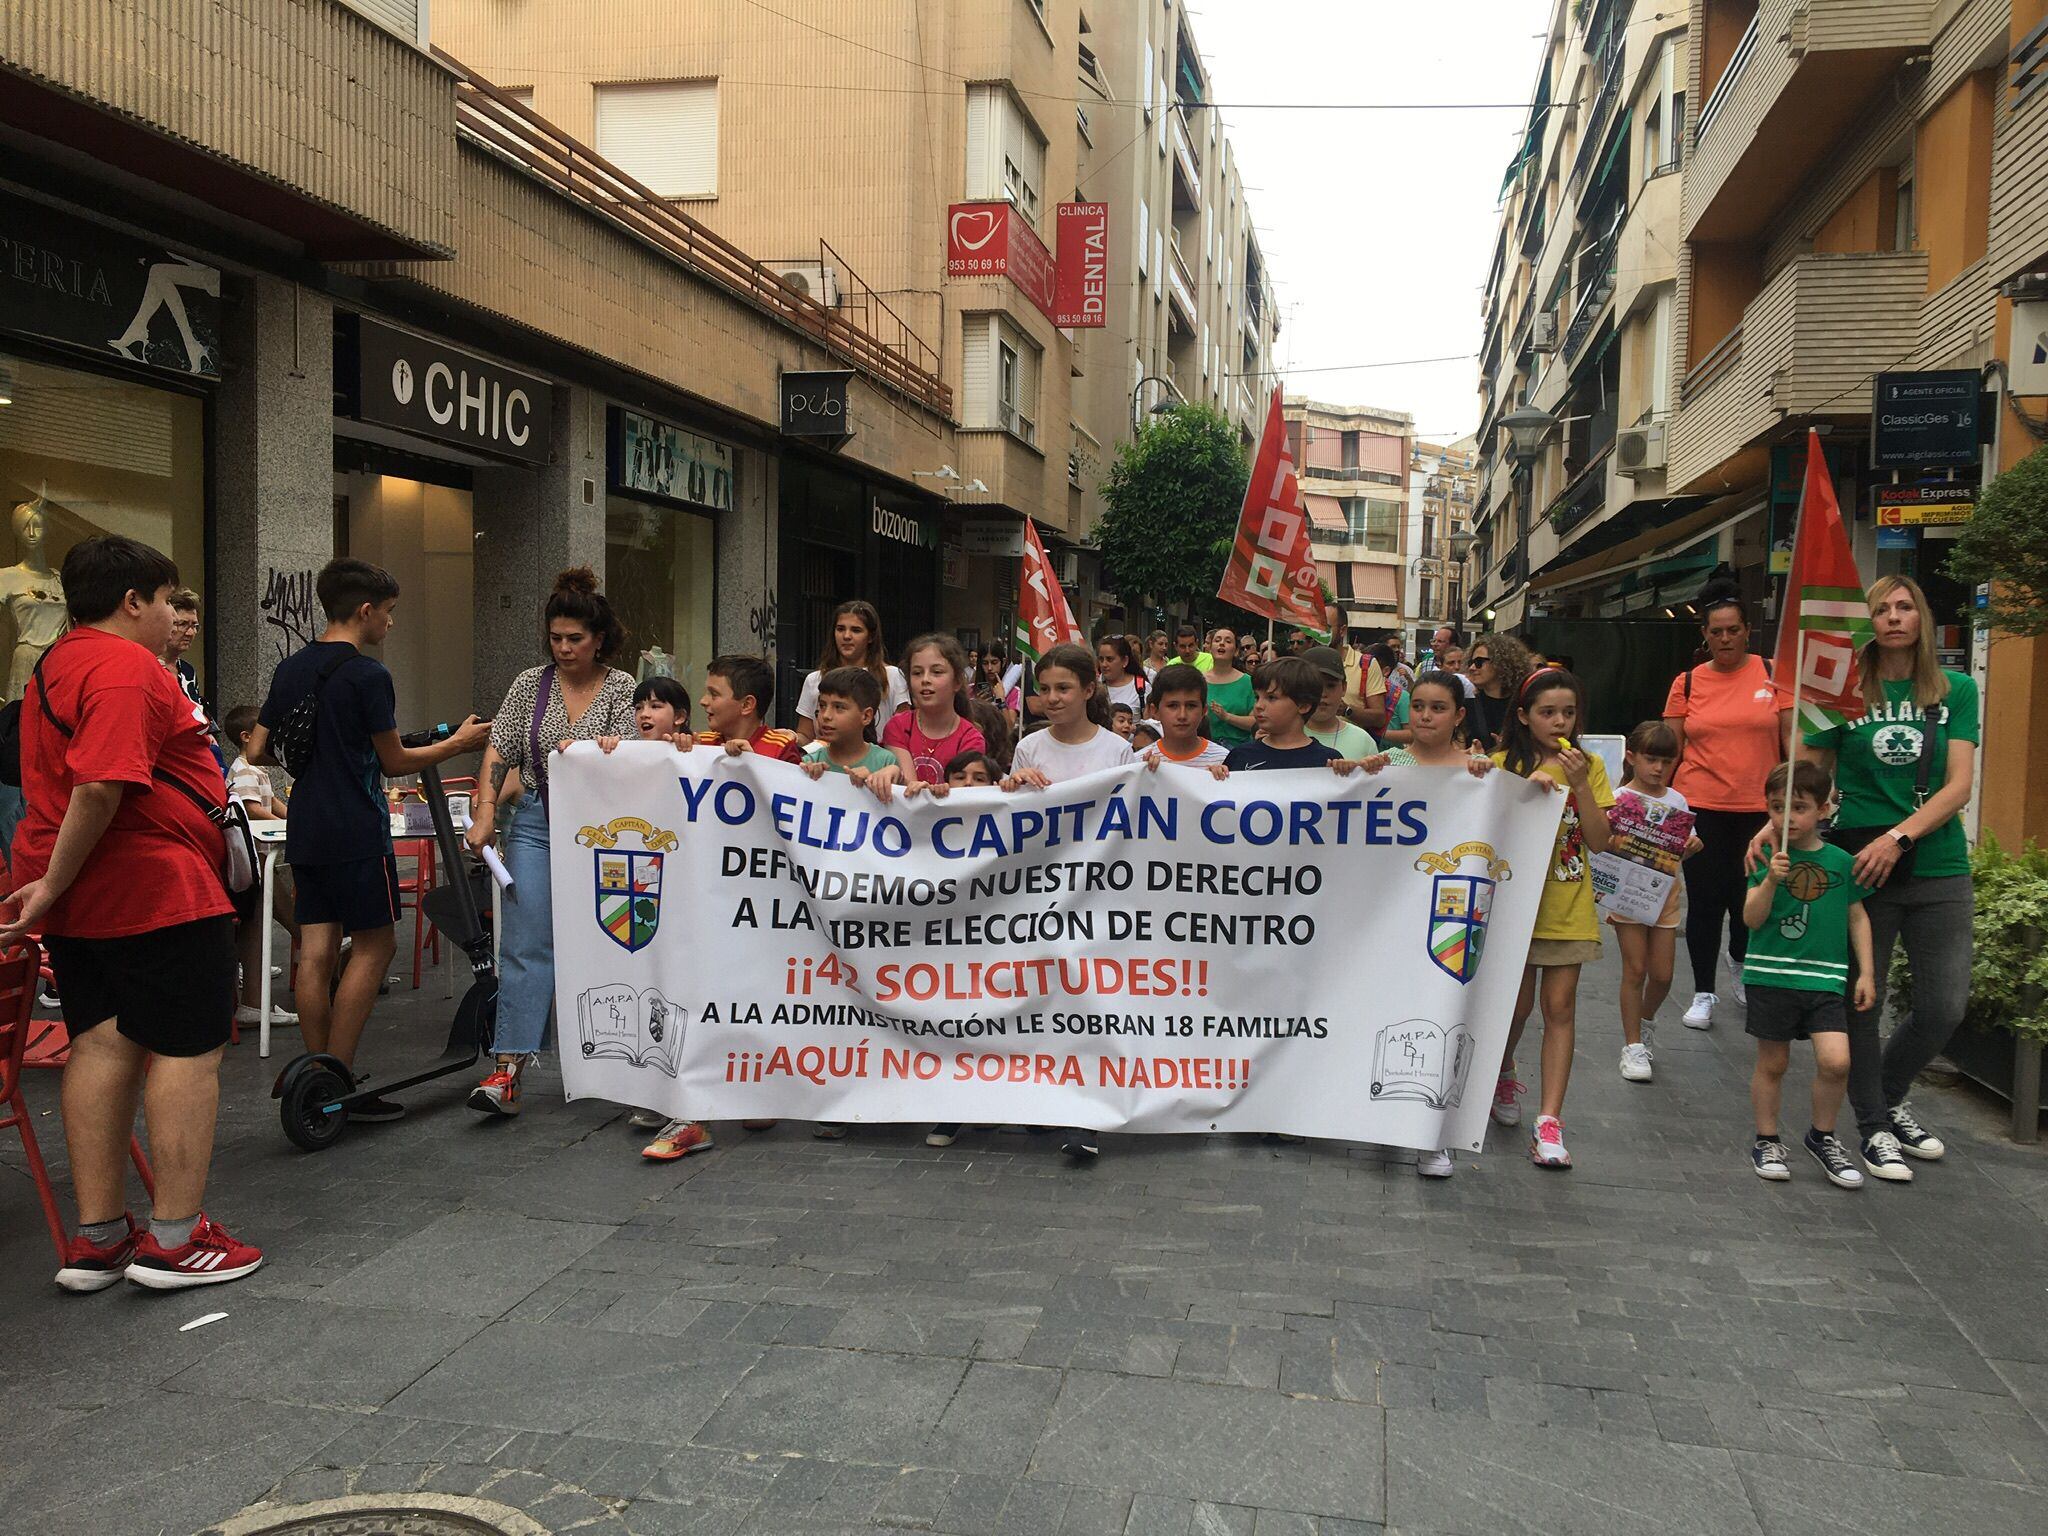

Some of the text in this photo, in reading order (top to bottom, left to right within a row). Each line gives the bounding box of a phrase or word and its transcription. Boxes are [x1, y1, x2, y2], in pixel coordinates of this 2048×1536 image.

[1059, 206, 1104, 216] CLINICA
[949, 258, 1006, 271] 953 50 69 16
[1083, 217, 1105, 313] DENTAL
[1057, 314, 1102, 323] 953 50 69 16
[425, 362, 530, 447] CHIC
[790, 387, 841, 423] pub
[1935, 387, 1966, 395] OFICIAL
[1881, 412, 1949, 426] ClassicGes
[1881, 487, 1970, 500] Kodak Express
[873, 496, 919, 546] bozoom
[678, 777, 1427, 859] YO ELIJO CAPITÁN CORTÉS
[970, 859, 1135, 902] NUESTRO
[1147, 861, 1322, 897] DERECHO
[731, 897, 758, 929] A
[772, 898, 815, 931] LA
[924, 901, 1093, 947] ELECCIÓN
[1108, 910, 1152, 941] DE
[1164, 911, 1316, 946] CENTRO
[876, 958, 1209, 1001] SOLICITUDES!!
[700, 1002, 1328, 1039] A LA ADMINISTRACIÓN LE SOBRAN 18 FAMILIAS
[882, 1048, 943, 1081] NO
[952, 1053, 1086, 1087] SOBRA
[1099, 1055, 1251, 1091] NADIE!!!
